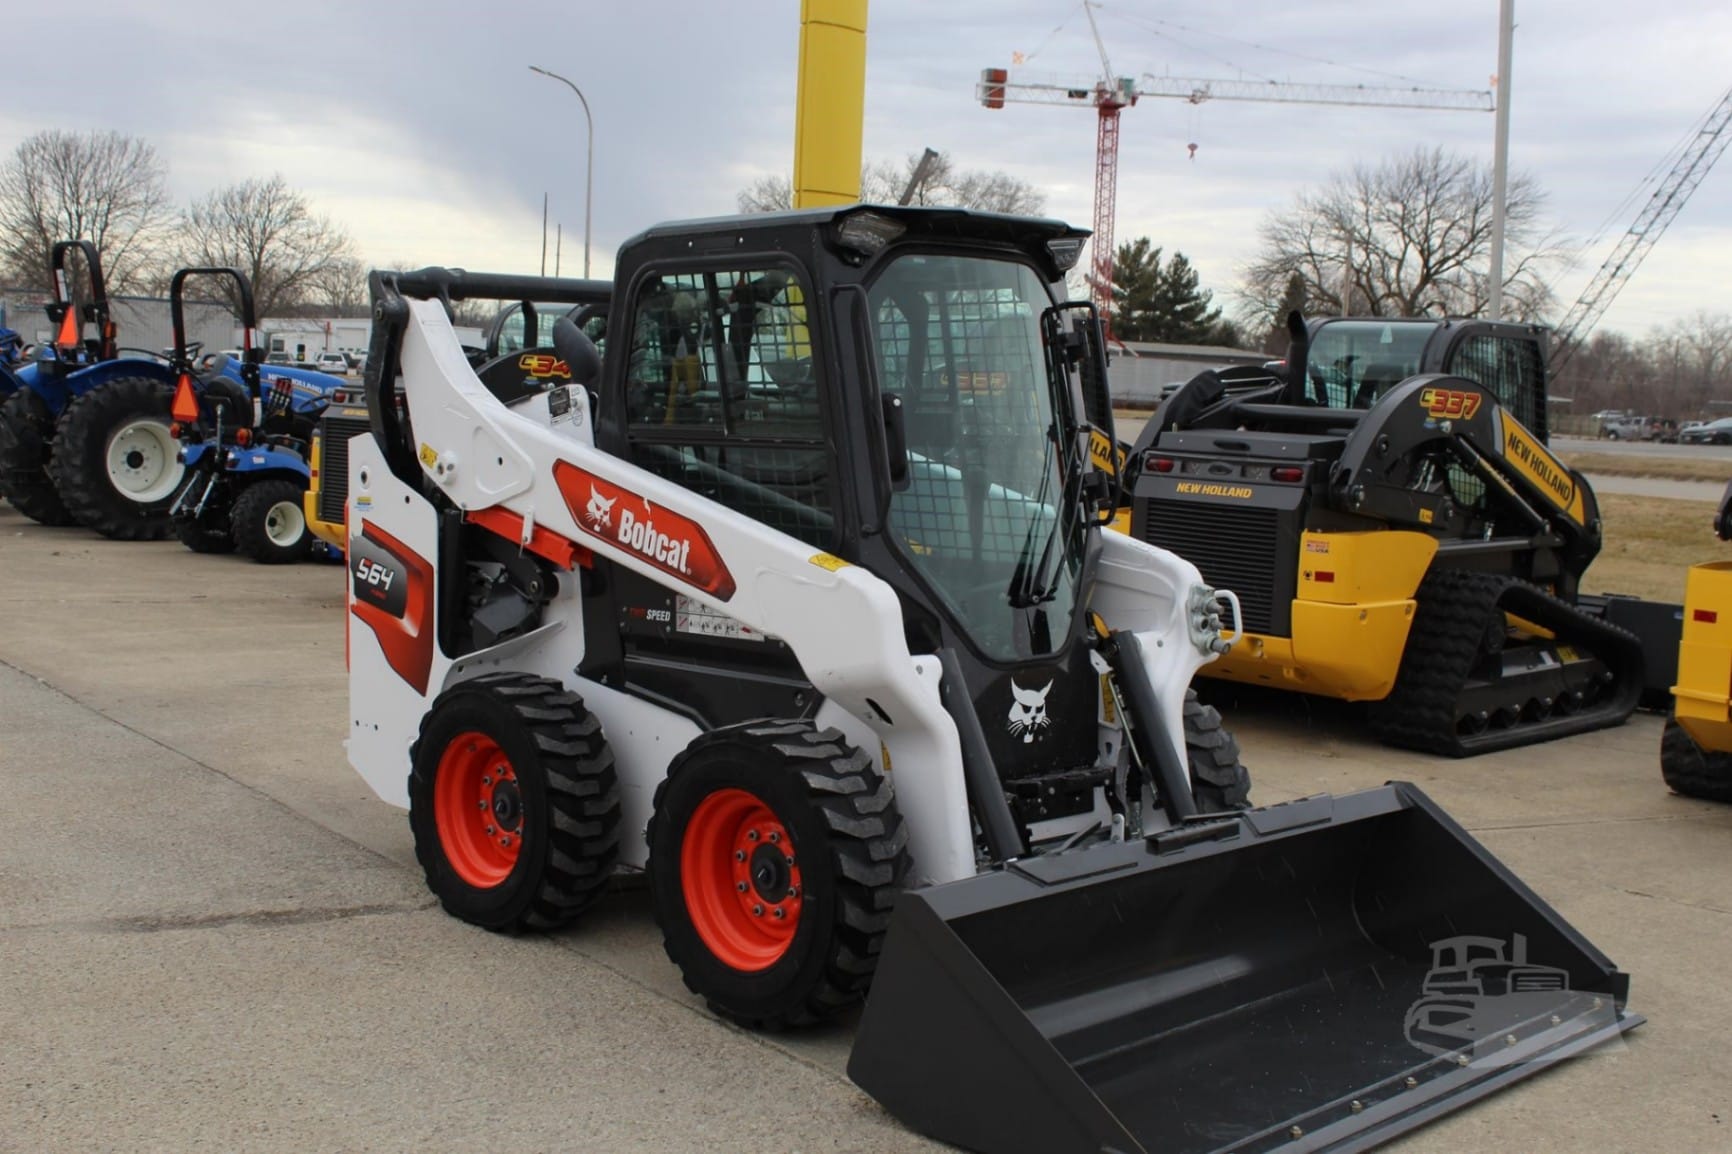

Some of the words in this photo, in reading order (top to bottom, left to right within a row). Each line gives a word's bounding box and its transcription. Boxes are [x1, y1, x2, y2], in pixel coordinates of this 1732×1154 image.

[1420, 388, 1482, 420] C337
[1507, 432, 1531, 464] NEW
[1529, 455, 1571, 502] HOLLAND
[1176, 482, 1201, 494] NEW
[1201, 484, 1252, 499] HOLLAND
[618, 508, 690, 574] Bobcat
[646, 609, 671, 622] SPEED
